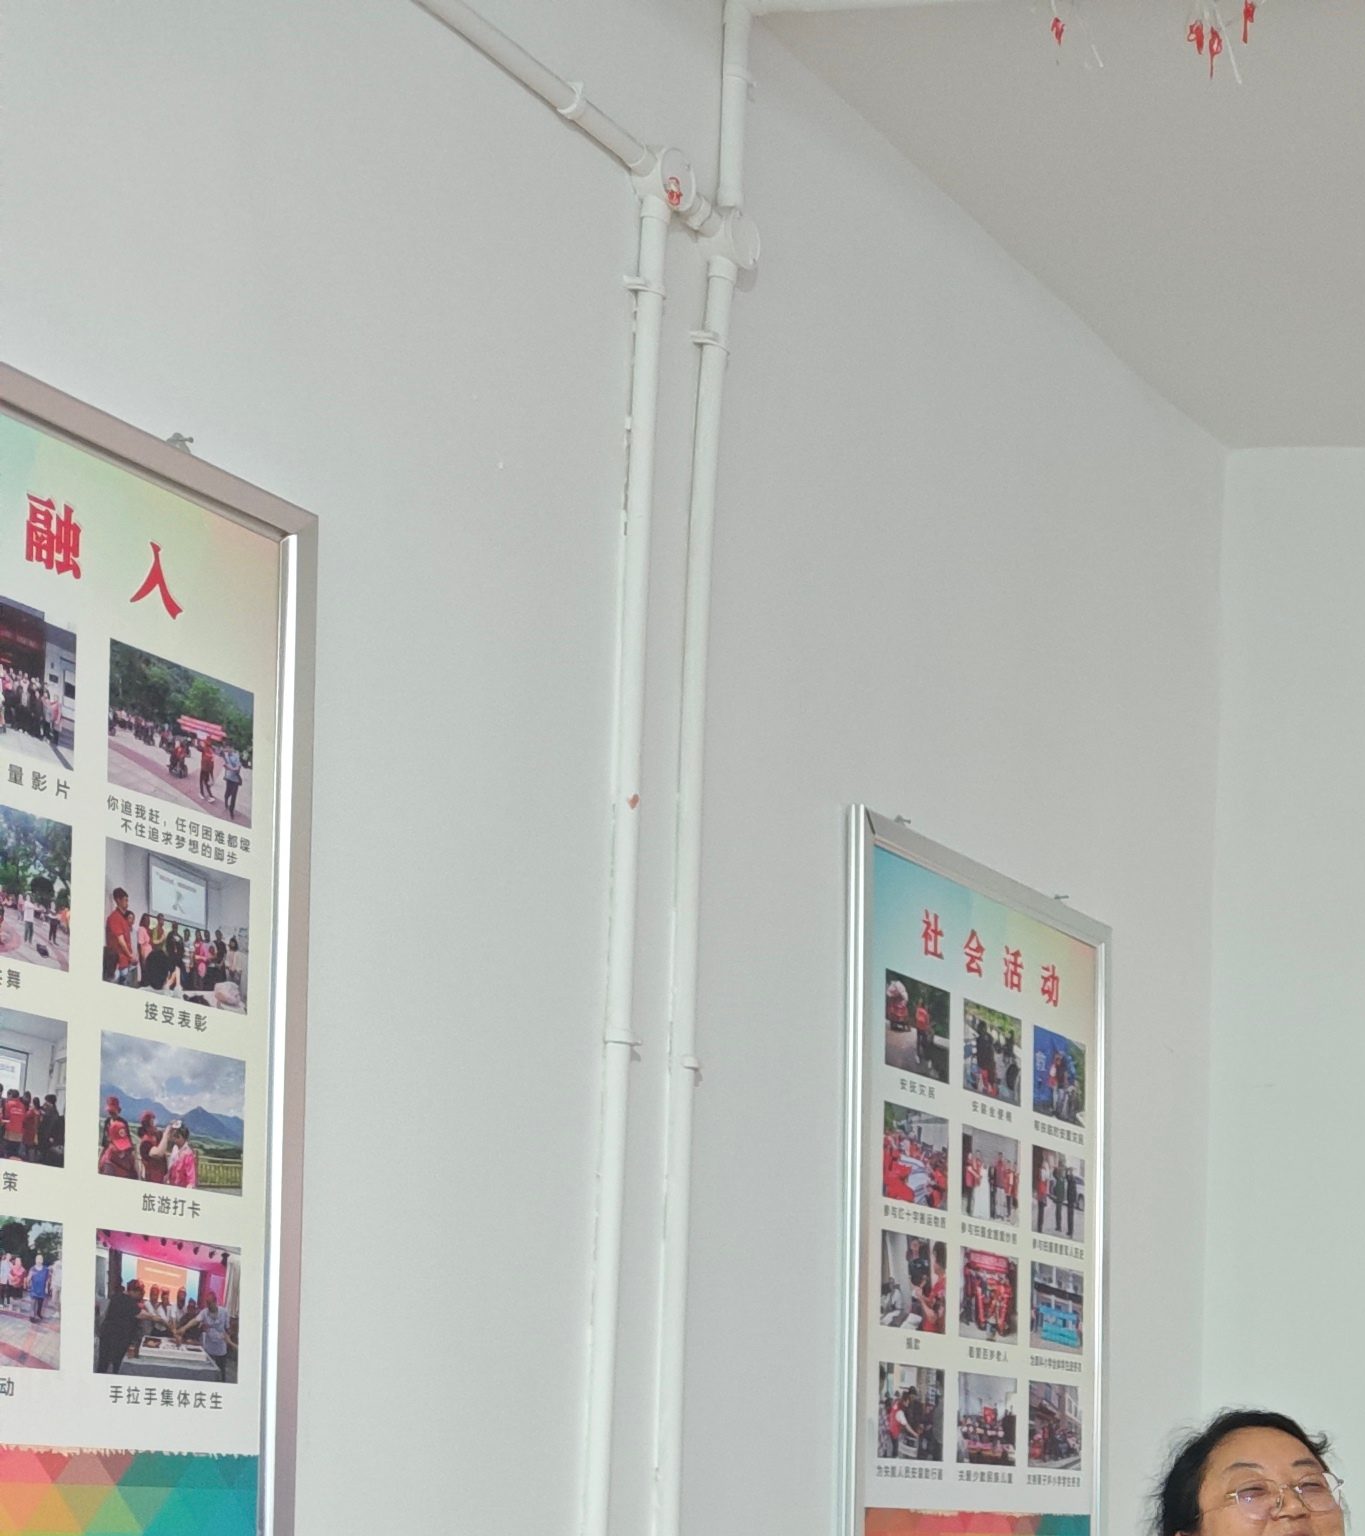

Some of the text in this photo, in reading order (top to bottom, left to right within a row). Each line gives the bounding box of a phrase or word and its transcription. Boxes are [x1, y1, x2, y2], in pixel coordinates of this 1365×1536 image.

[921, 909, 1060, 1007] 社会活动
[145, 1001, 207, 1032] 接受表彰
[142, 1193, 201, 1218] 旅游打卡
[109, 1385, 223, 1410] 手拉手集体庆生
